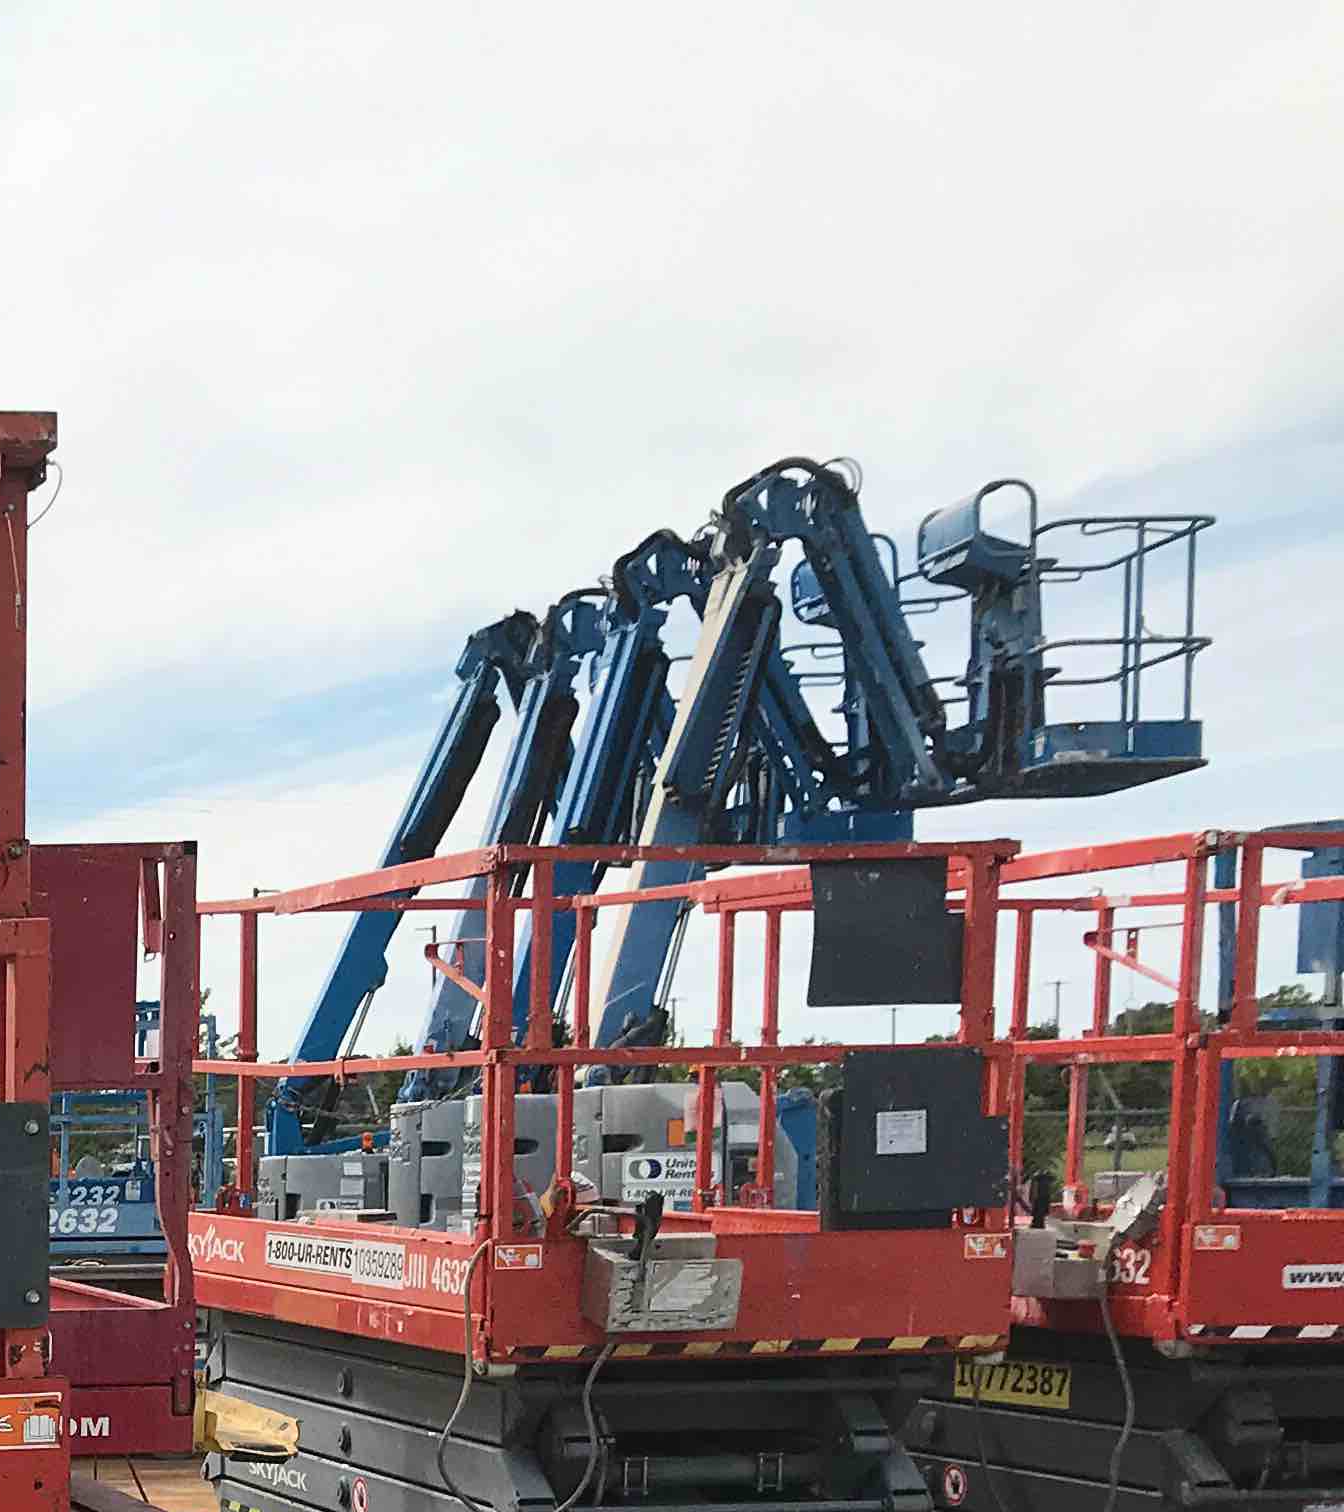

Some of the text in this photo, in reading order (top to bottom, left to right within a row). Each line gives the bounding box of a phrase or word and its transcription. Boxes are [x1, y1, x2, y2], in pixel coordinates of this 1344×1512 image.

[665, 1158, 697, 1169] Unit
[188, 1223, 245, 1264] KYJACK
[267, 1239, 352, 1269] 1-800-UR-RENTS
